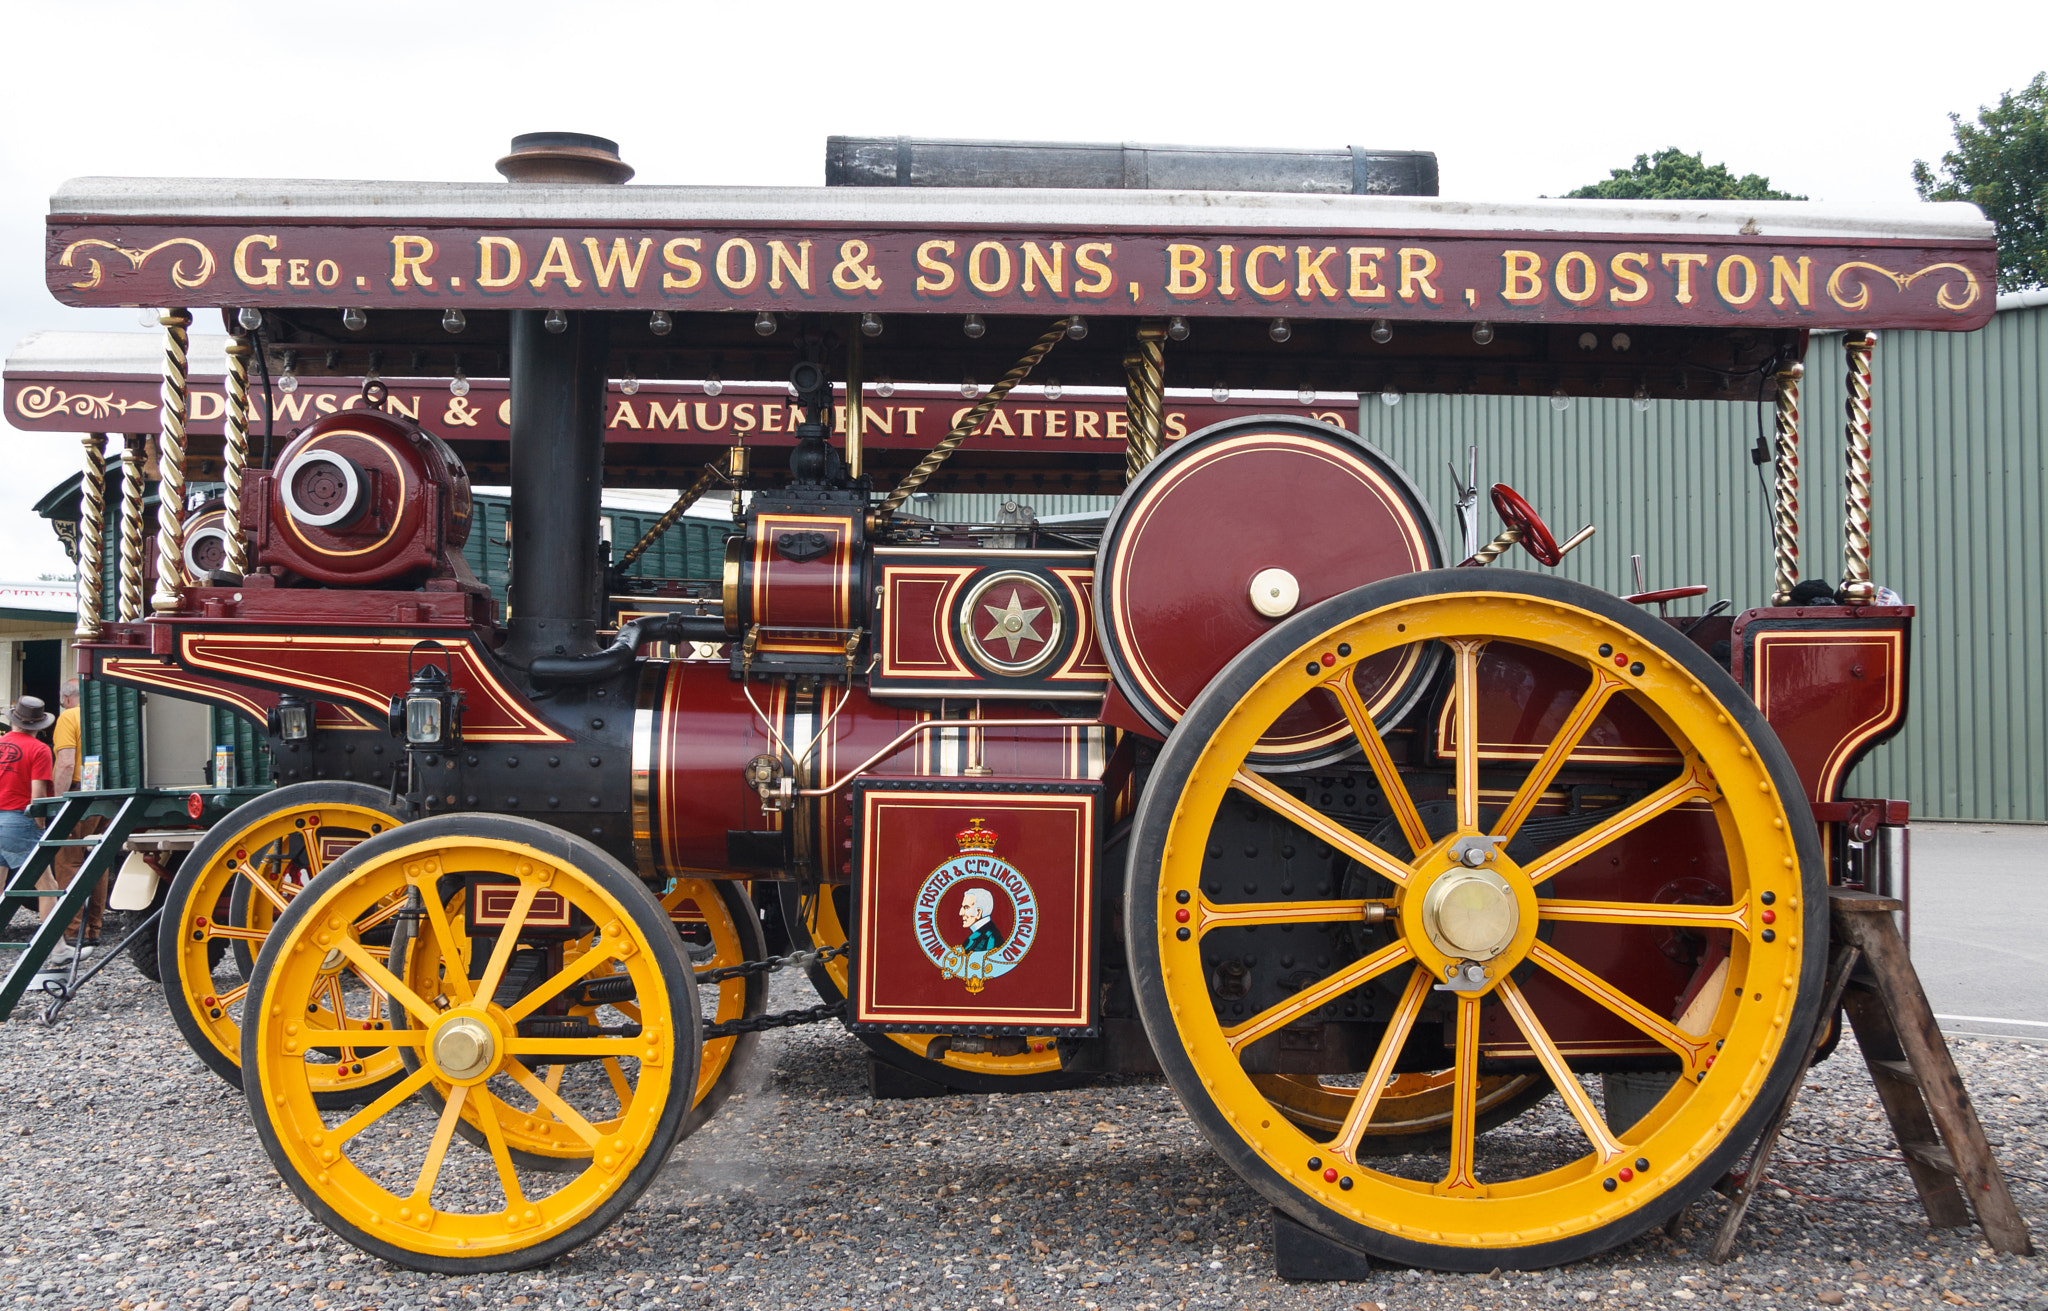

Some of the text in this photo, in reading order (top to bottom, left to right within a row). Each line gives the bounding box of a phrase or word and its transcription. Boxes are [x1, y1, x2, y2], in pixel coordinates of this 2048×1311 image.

[476, 235, 813, 291] DAWSON
[832, 238, 884, 292] &
[1500, 249, 1813, 306] BOSTON
[443, 396, 482, 427] &
[951, 407, 1188, 440] CATERES
[919, 869, 954, 909] FOSTER
[952, 865, 966, 877] &
[989, 862, 1031, 906] LINCOLN
[918, 911, 946, 961] WILLIAM
